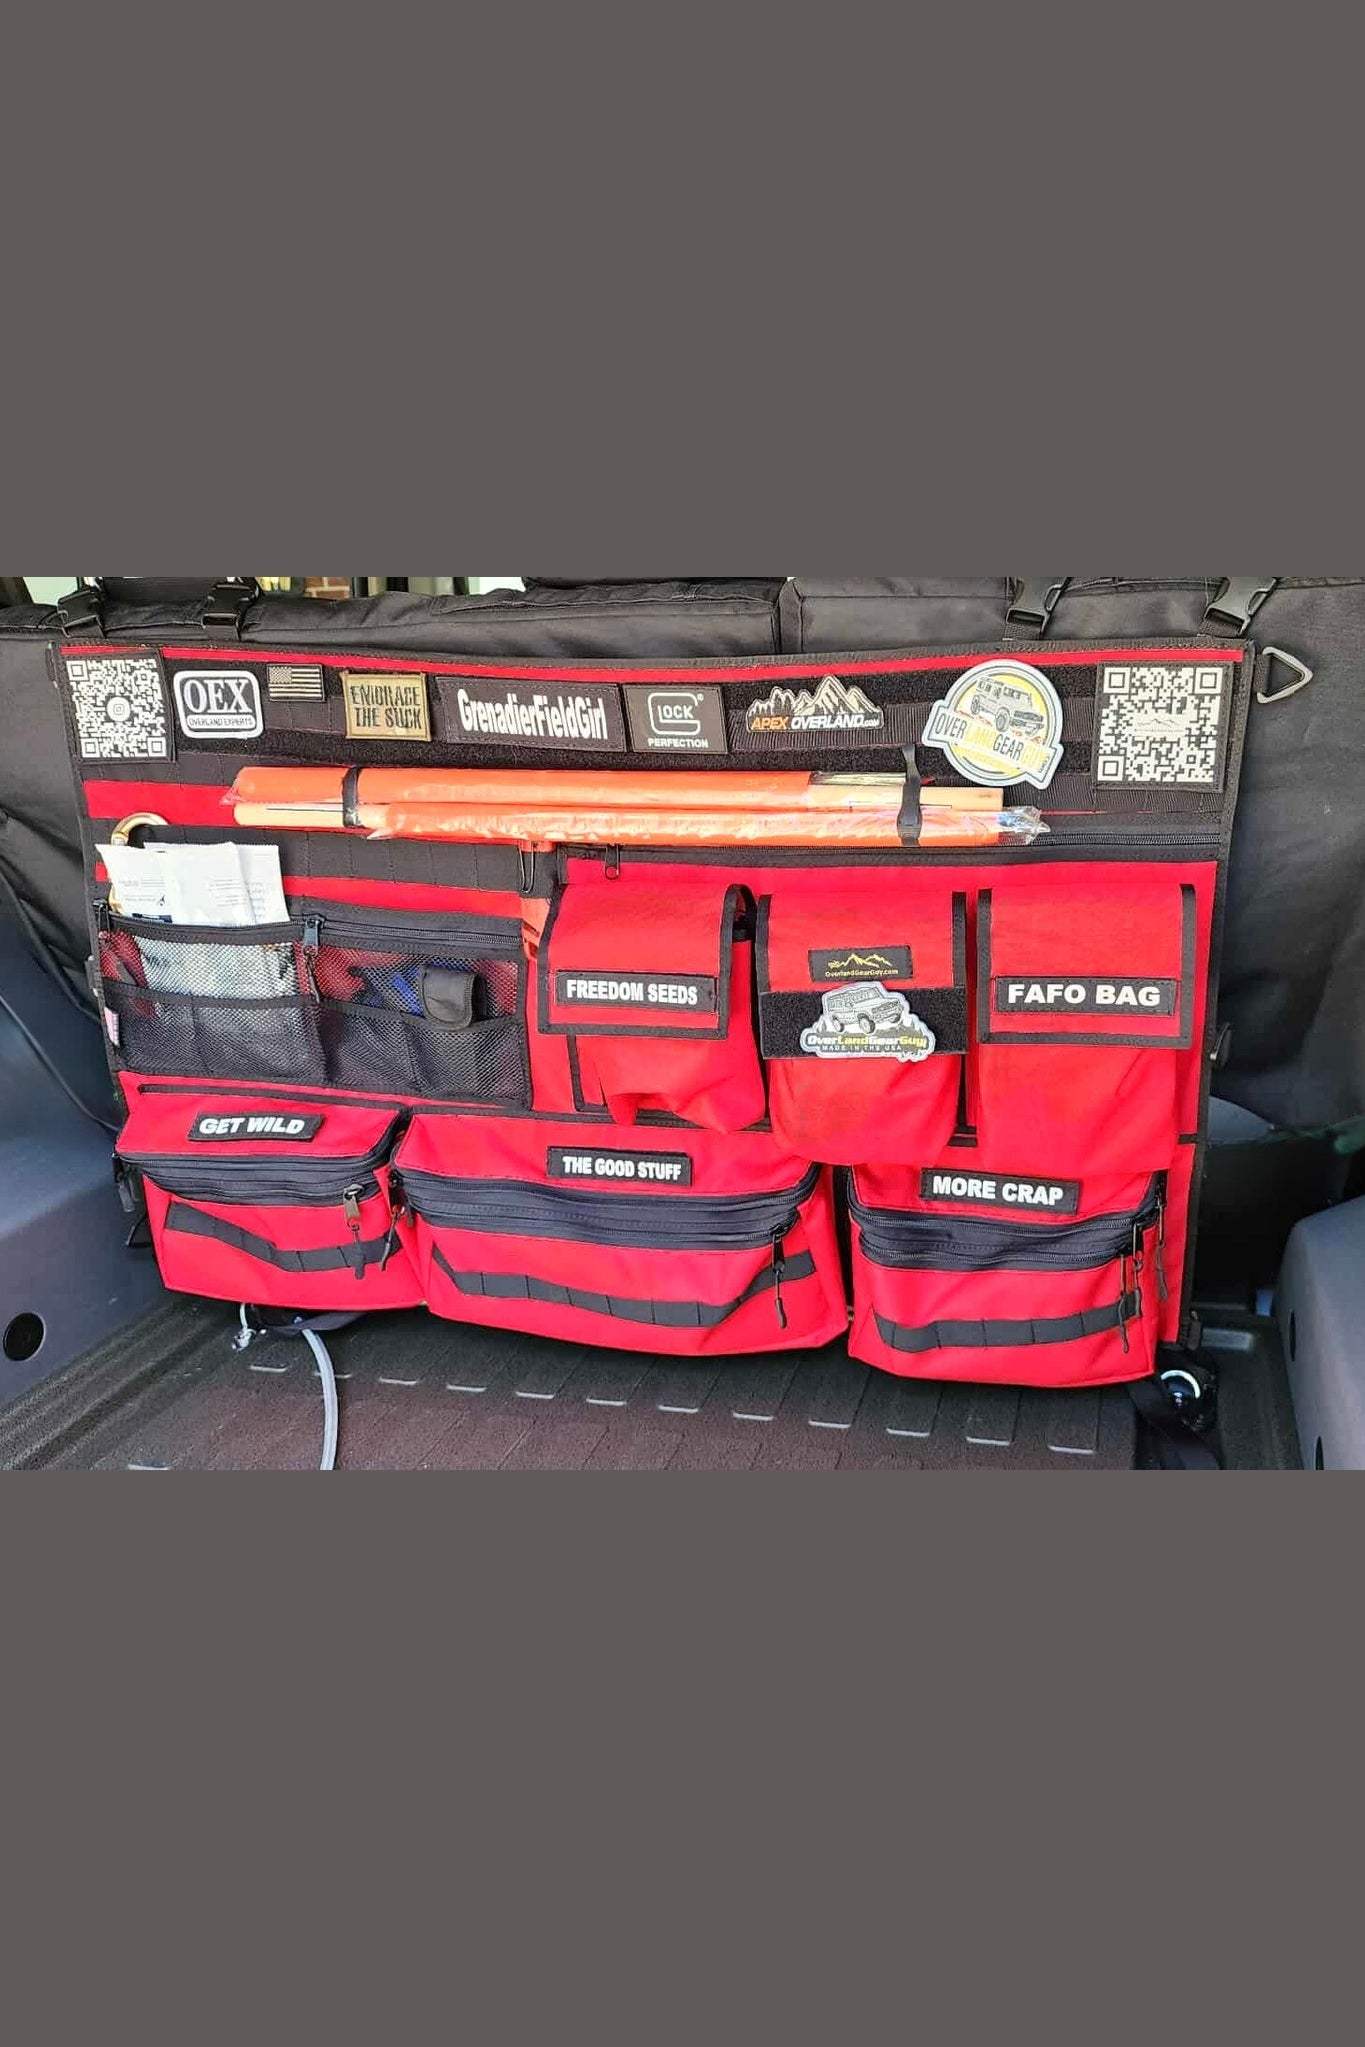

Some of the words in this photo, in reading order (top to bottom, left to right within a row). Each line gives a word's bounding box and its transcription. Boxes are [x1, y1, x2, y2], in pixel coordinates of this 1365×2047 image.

[183, 679, 254, 713] OEX
[354, 707, 380, 728] THE
[384, 706, 422, 730] SUCK
[457, 688, 608, 740] GrenadierFieldGirl
[751, 717, 789, 730] APEX
[648, 738, 709, 748] PERFECTION
[566, 979, 643, 1001] FREEDOM
[647, 983, 698, 1005] SEEDS
[1008, 984, 1086, 1004] FAFO
[1095, 985, 1160, 1006] BAG
[199, 1117, 246, 1134] GET
[246, 1117, 305, 1134] WILD
[562, 1156, 592, 1174] THE
[594, 1157, 635, 1177] GOOD
[637, 1161, 682, 1180] STUFF
[932, 1176, 996, 1199] MORE
[1002, 1182, 1064, 1206] CRAP
